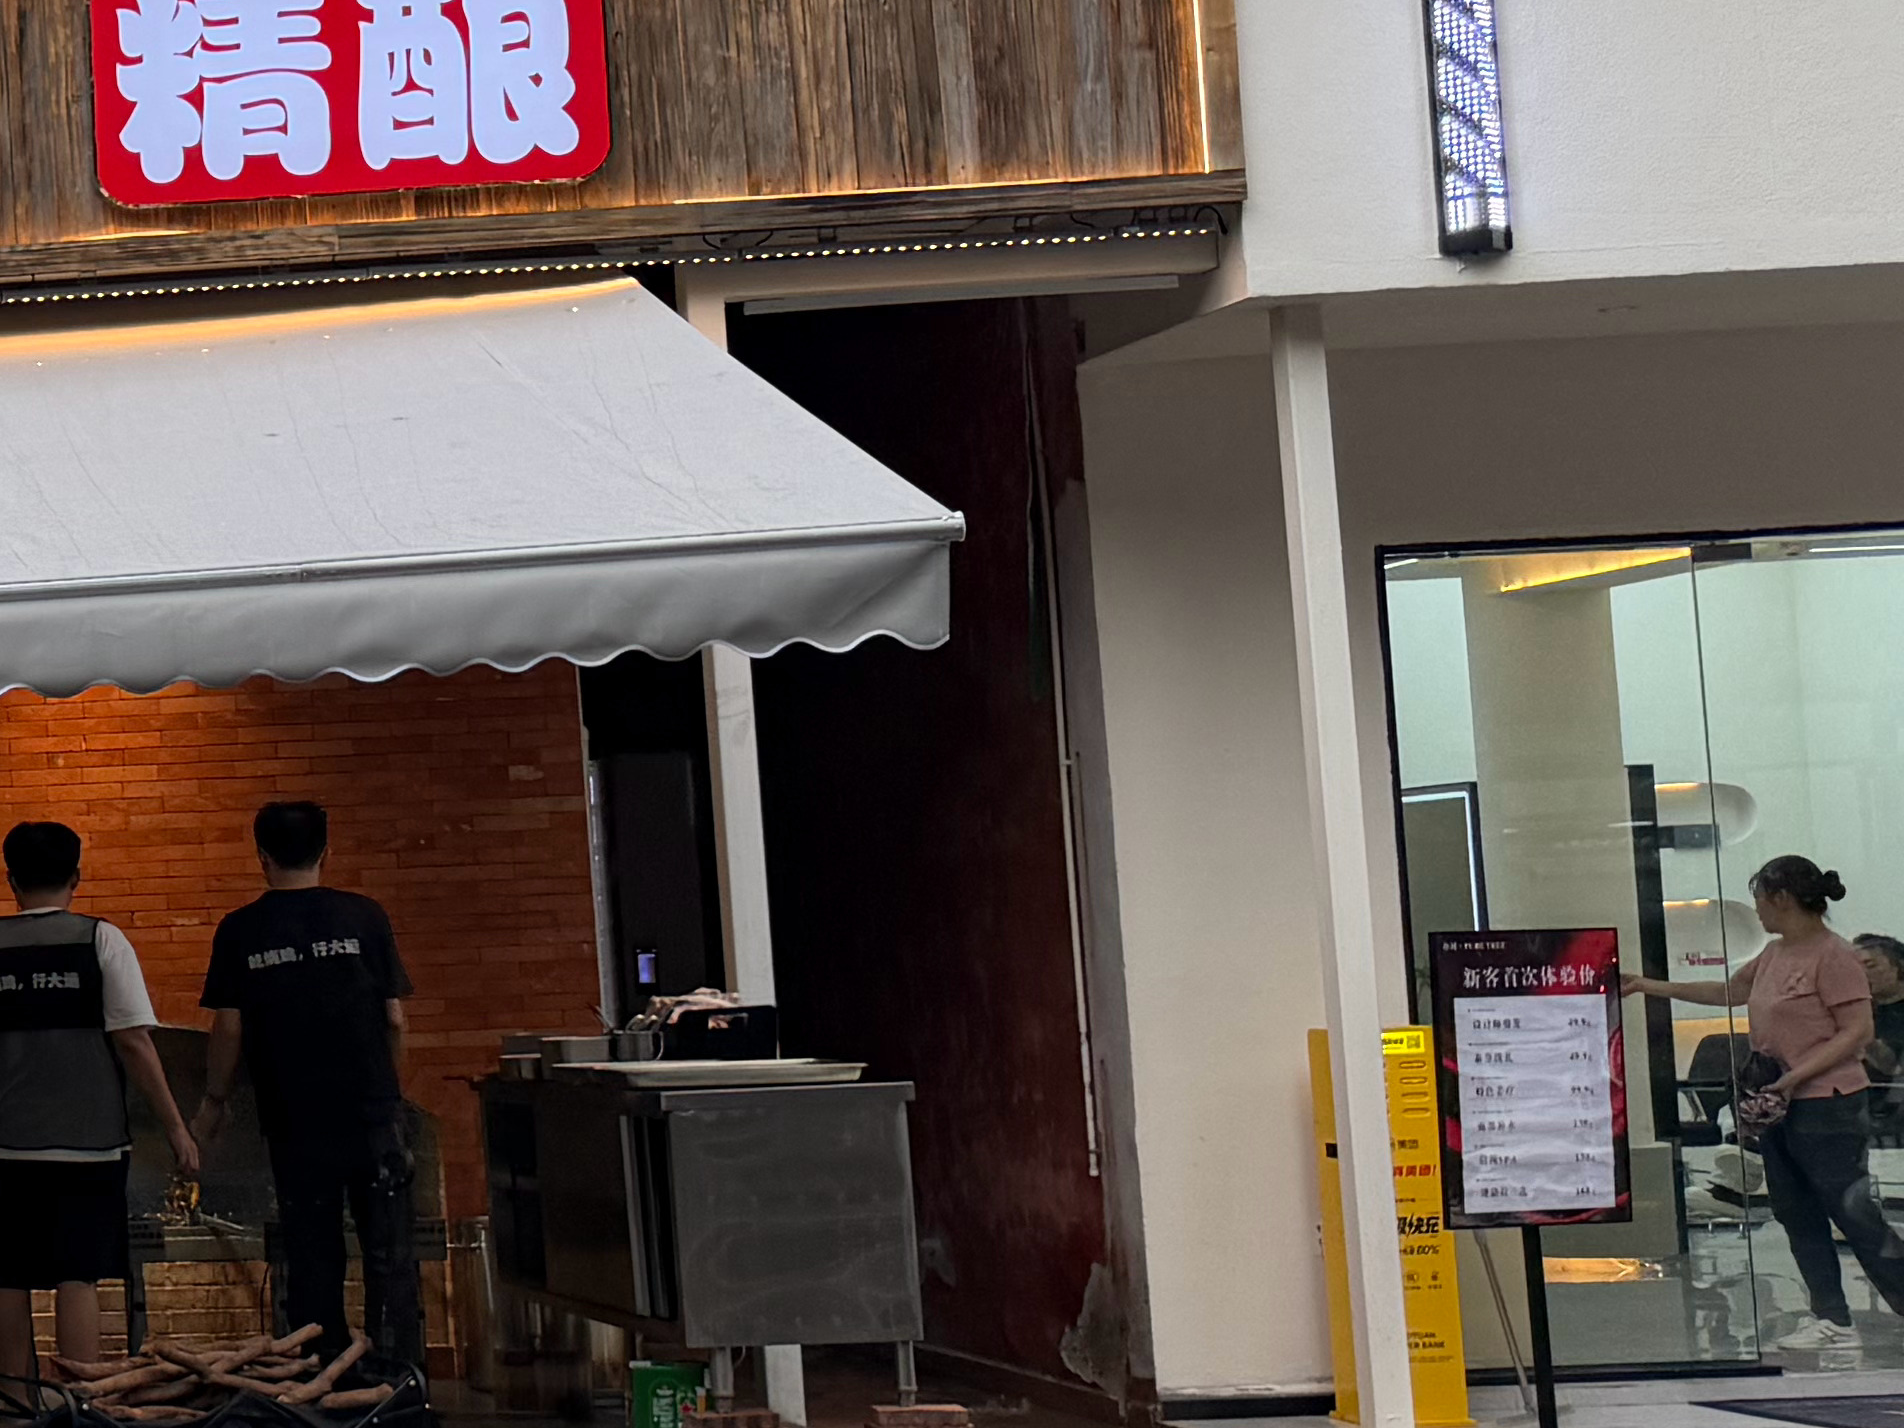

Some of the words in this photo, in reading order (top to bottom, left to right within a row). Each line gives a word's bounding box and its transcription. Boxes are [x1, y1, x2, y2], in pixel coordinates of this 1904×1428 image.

[1463, 963, 1595, 989] 新客首次体验价
